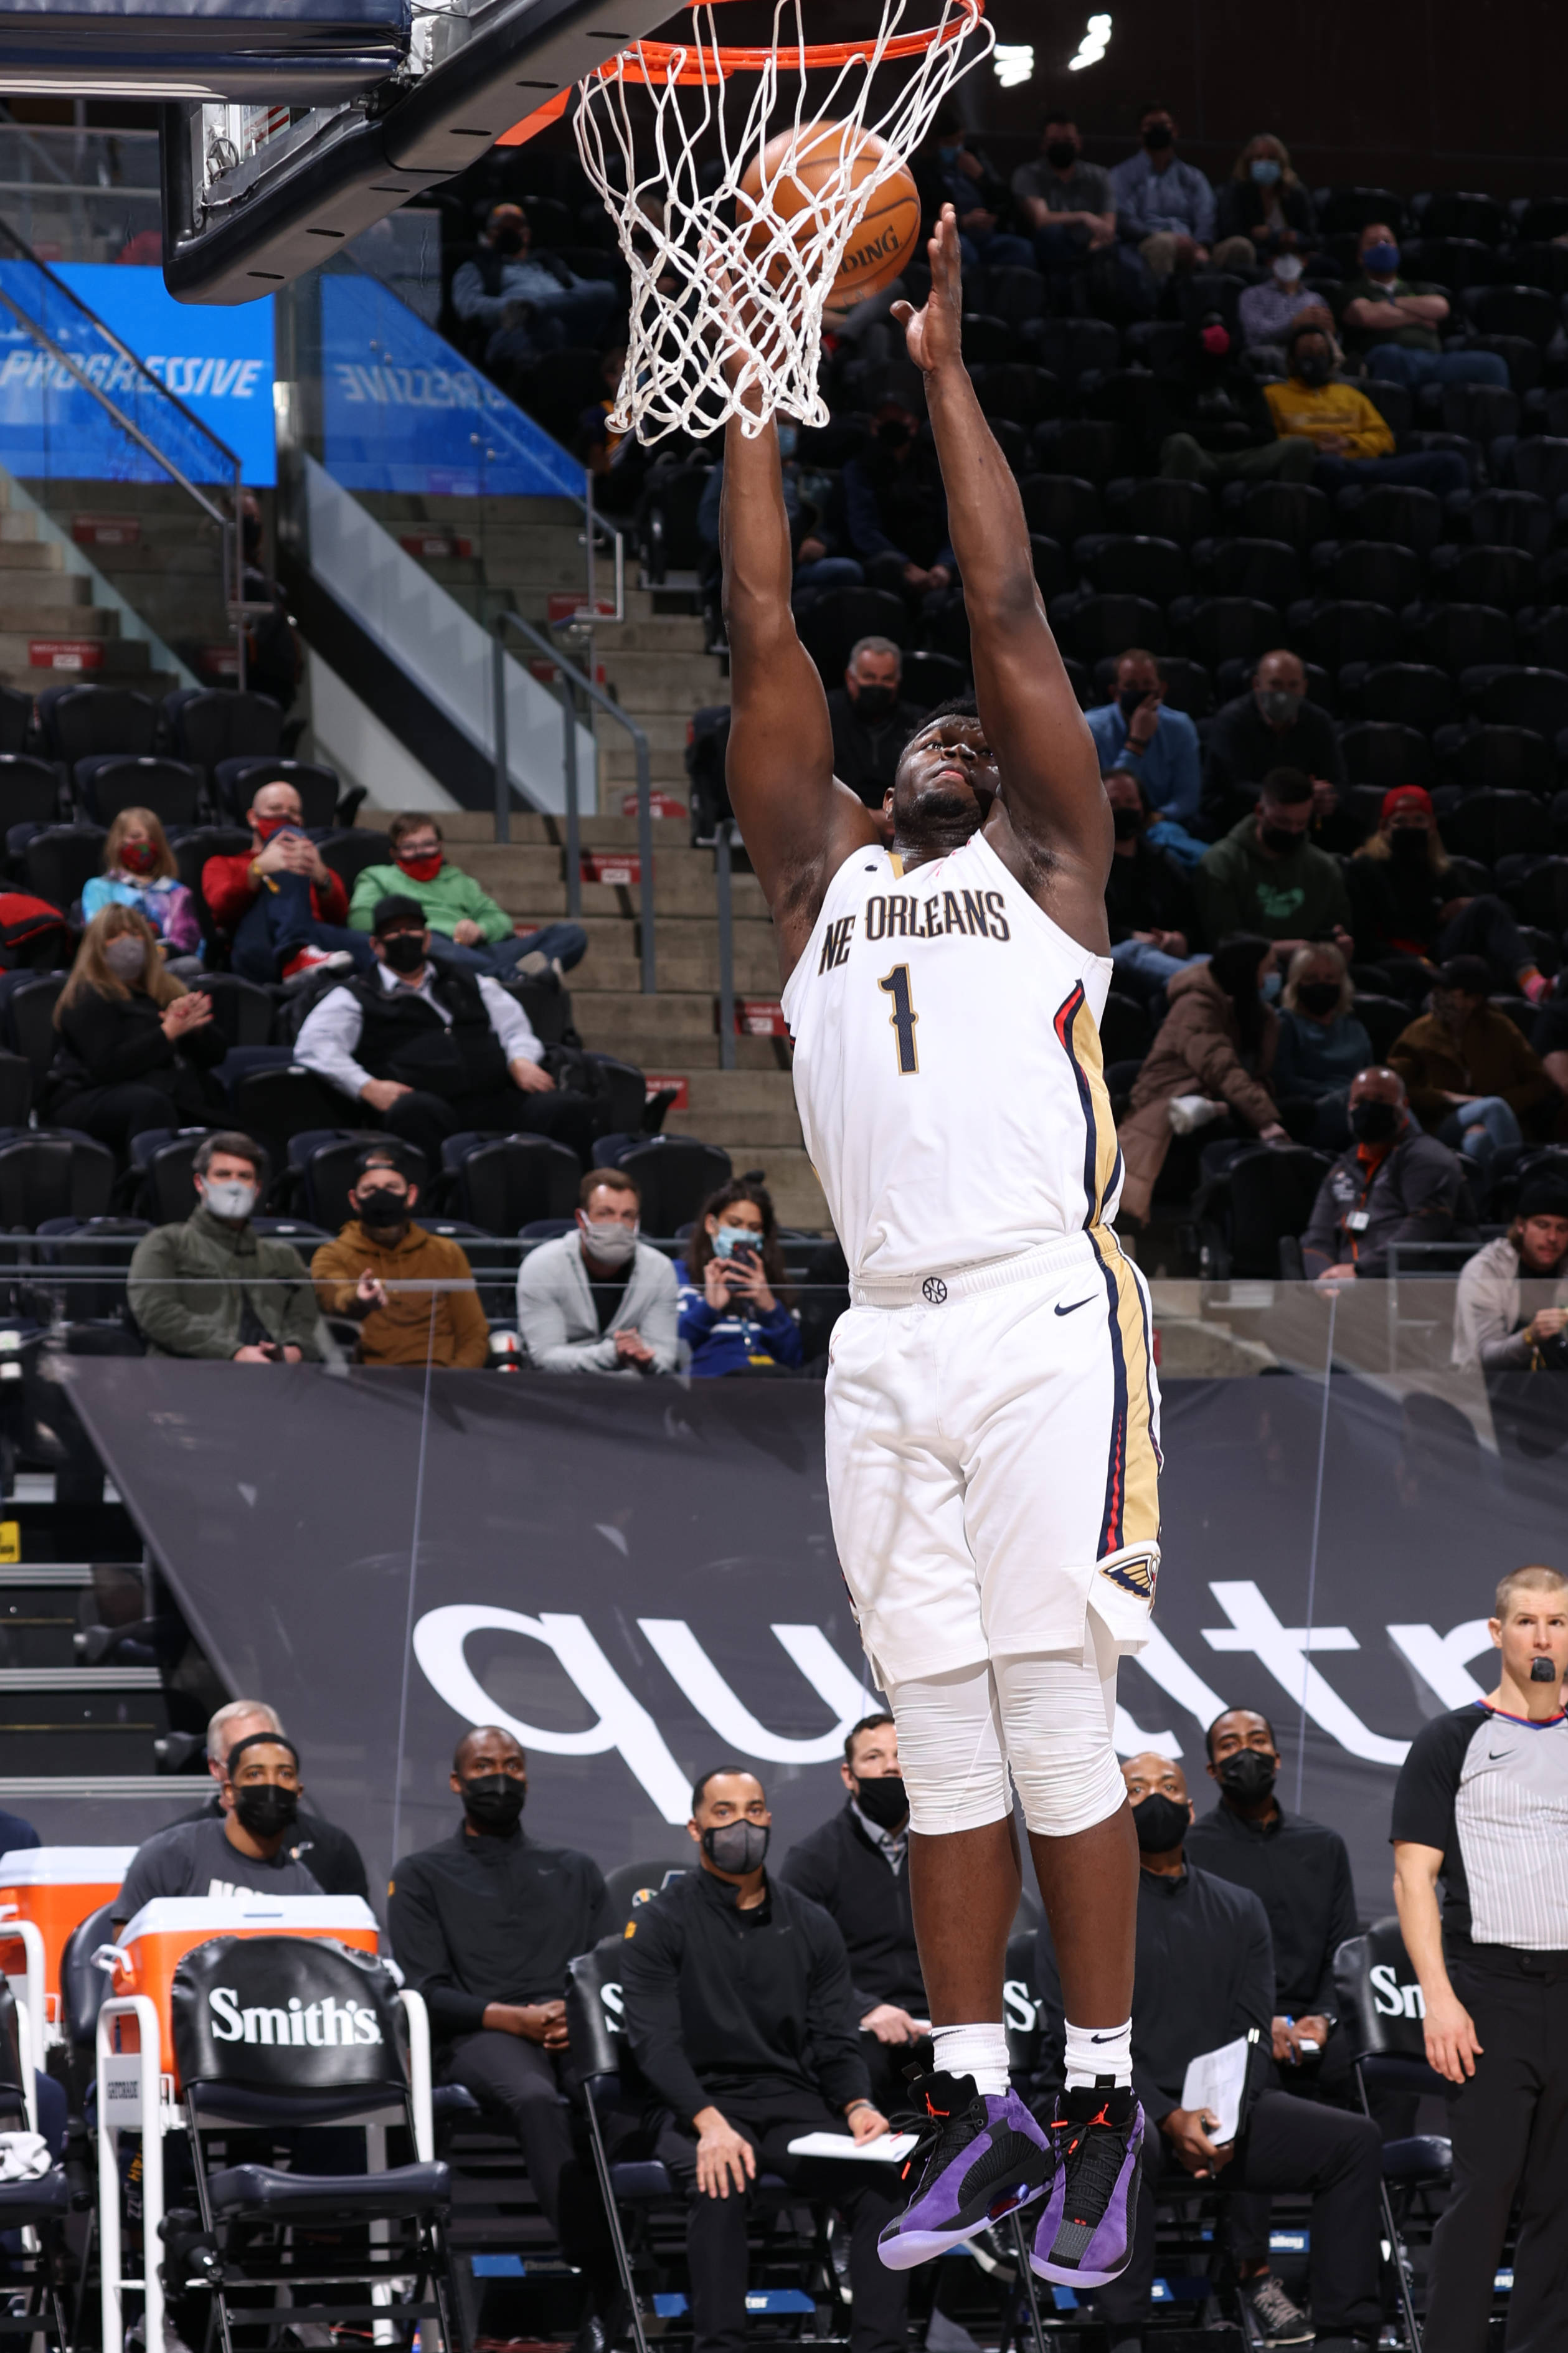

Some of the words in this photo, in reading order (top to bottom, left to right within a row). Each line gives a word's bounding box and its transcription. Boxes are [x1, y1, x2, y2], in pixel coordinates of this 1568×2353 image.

[0, 349, 263, 397] PROGRESSIVE
[818, 914, 856, 977] NE
[865, 889, 1011, 942] ORLEANS
[877, 962, 919, 1077] 1
[209, 1987, 381, 2047] Smith's
